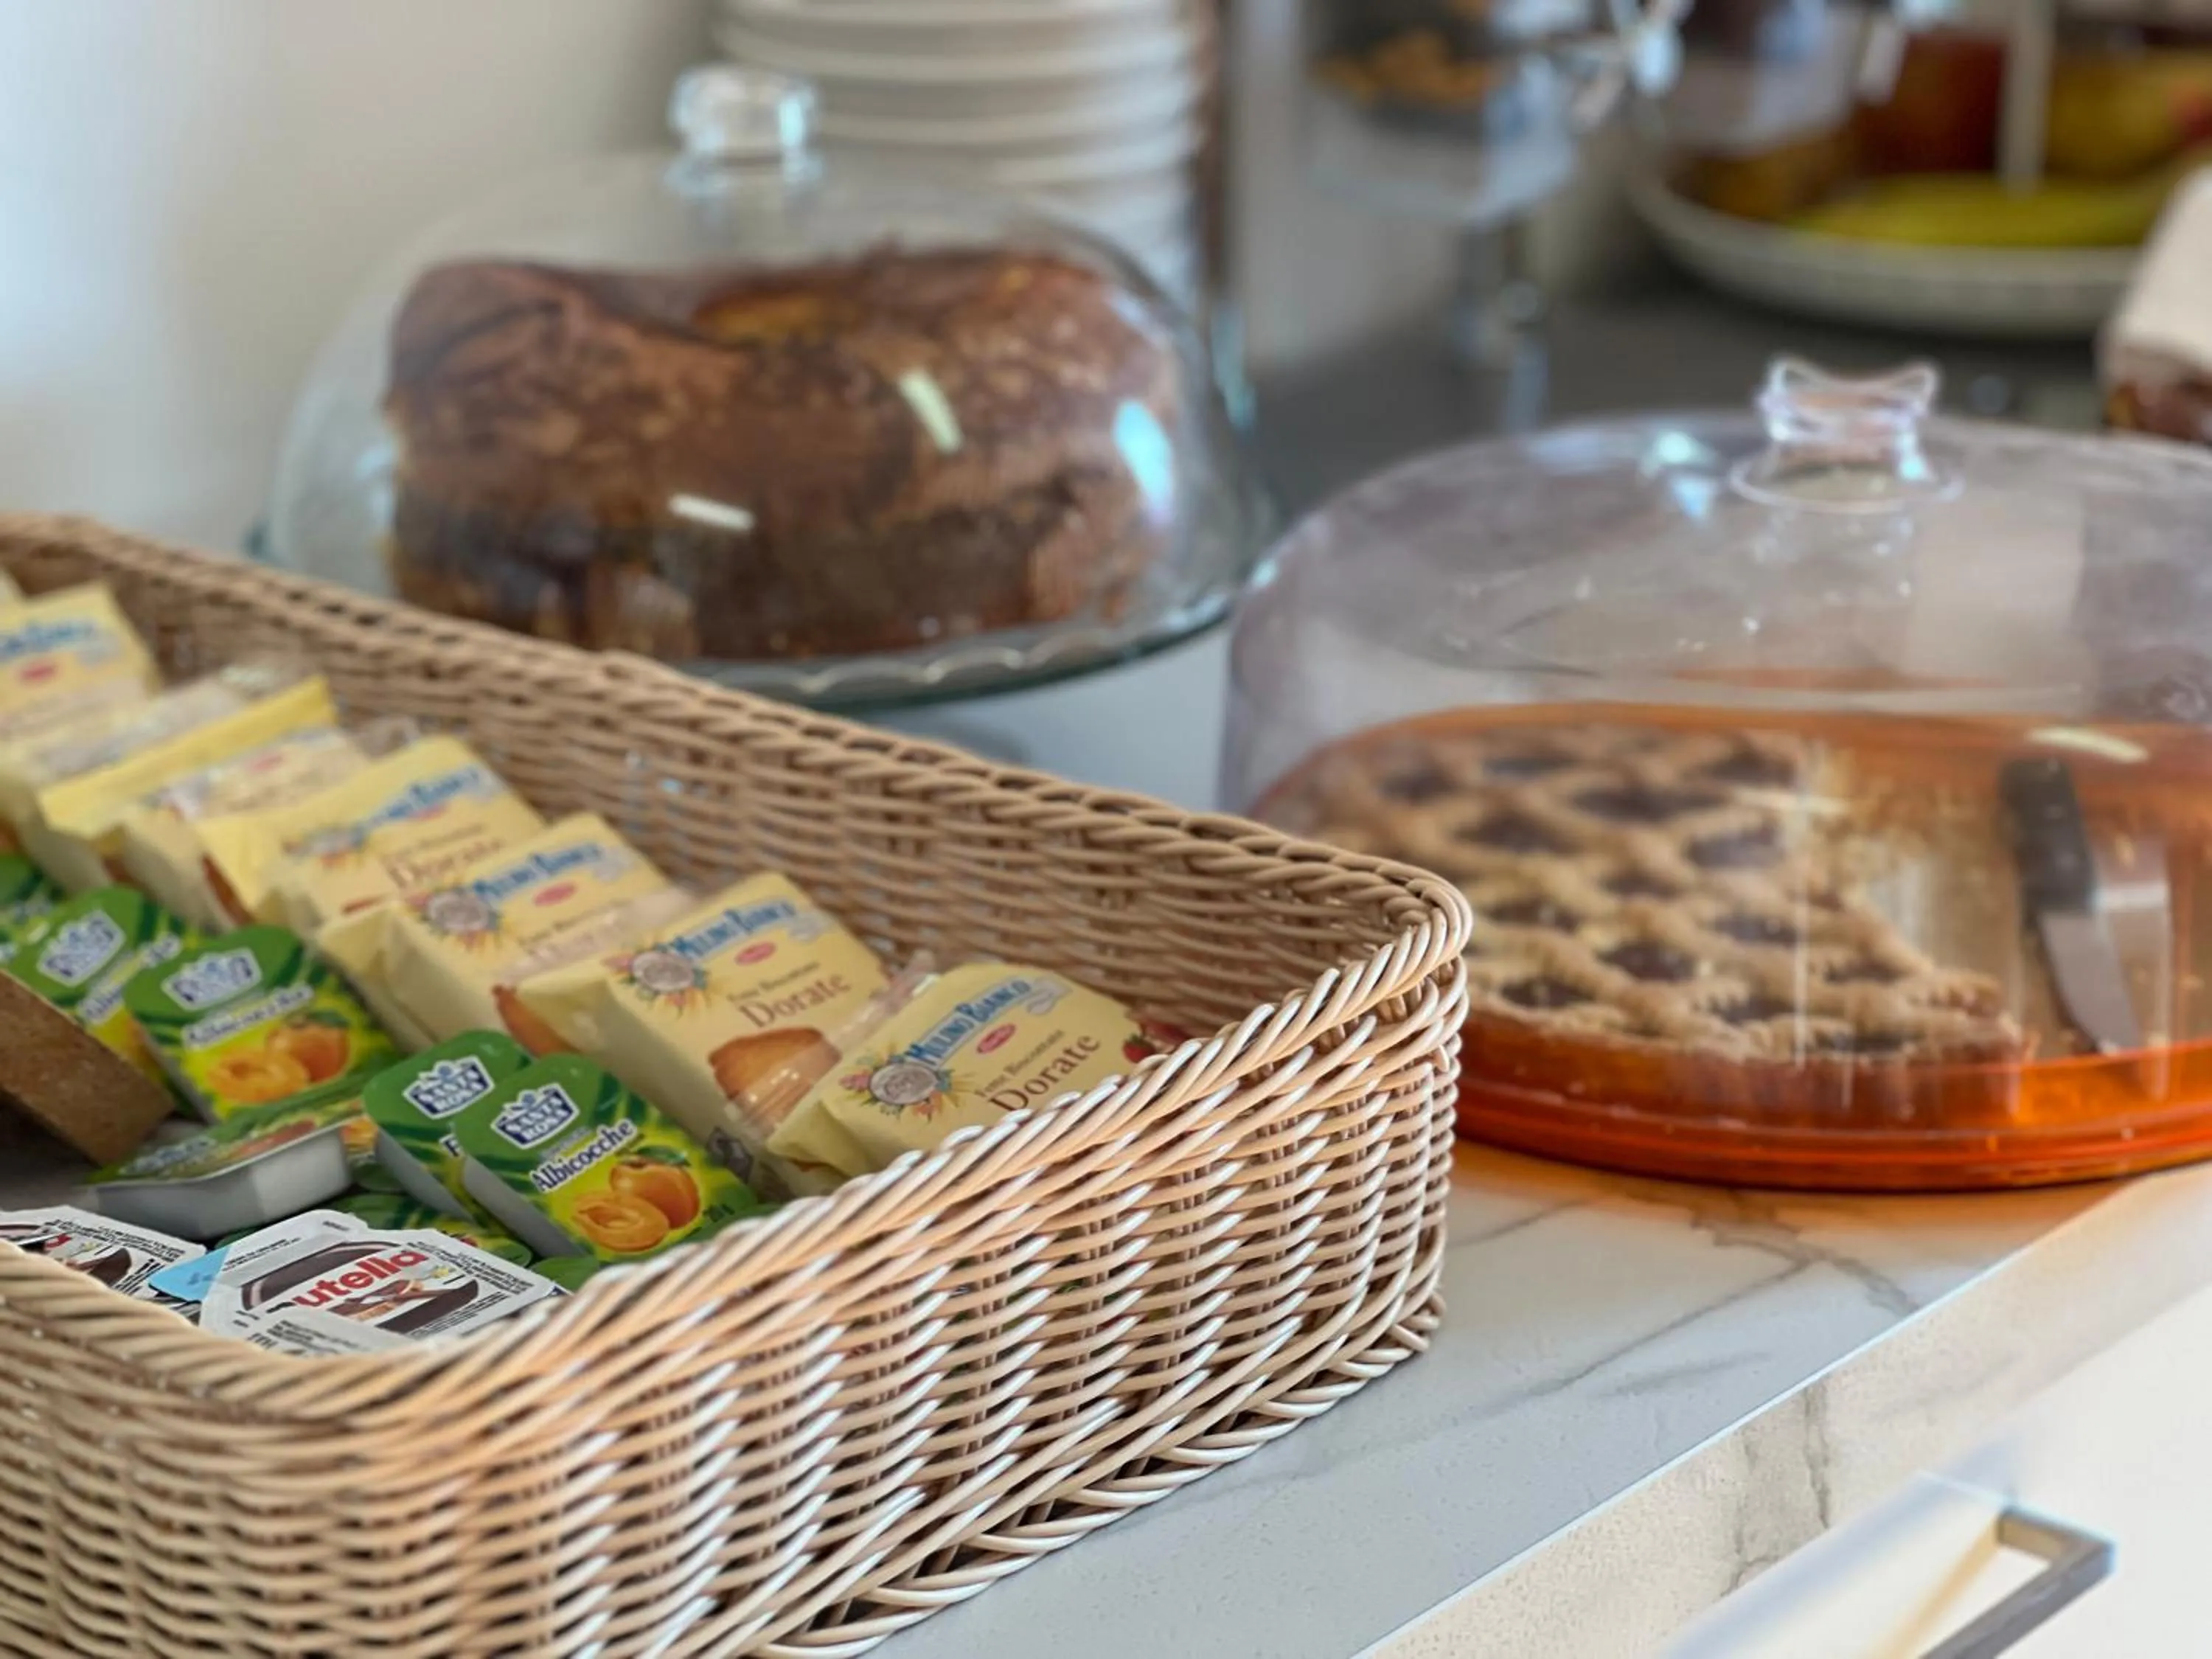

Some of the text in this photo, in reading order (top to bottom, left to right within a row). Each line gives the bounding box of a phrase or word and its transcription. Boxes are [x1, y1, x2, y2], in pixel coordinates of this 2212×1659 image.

[739, 974, 852, 1029] Dorate
[417, 1068, 479, 1104] SANTA
[987, 1034, 1101, 1111] Dorate
[505, 1096, 563, 1134] SANTA
[521, 1107, 570, 1140] ROSA
[532, 1120, 634, 1192] Albicocche
